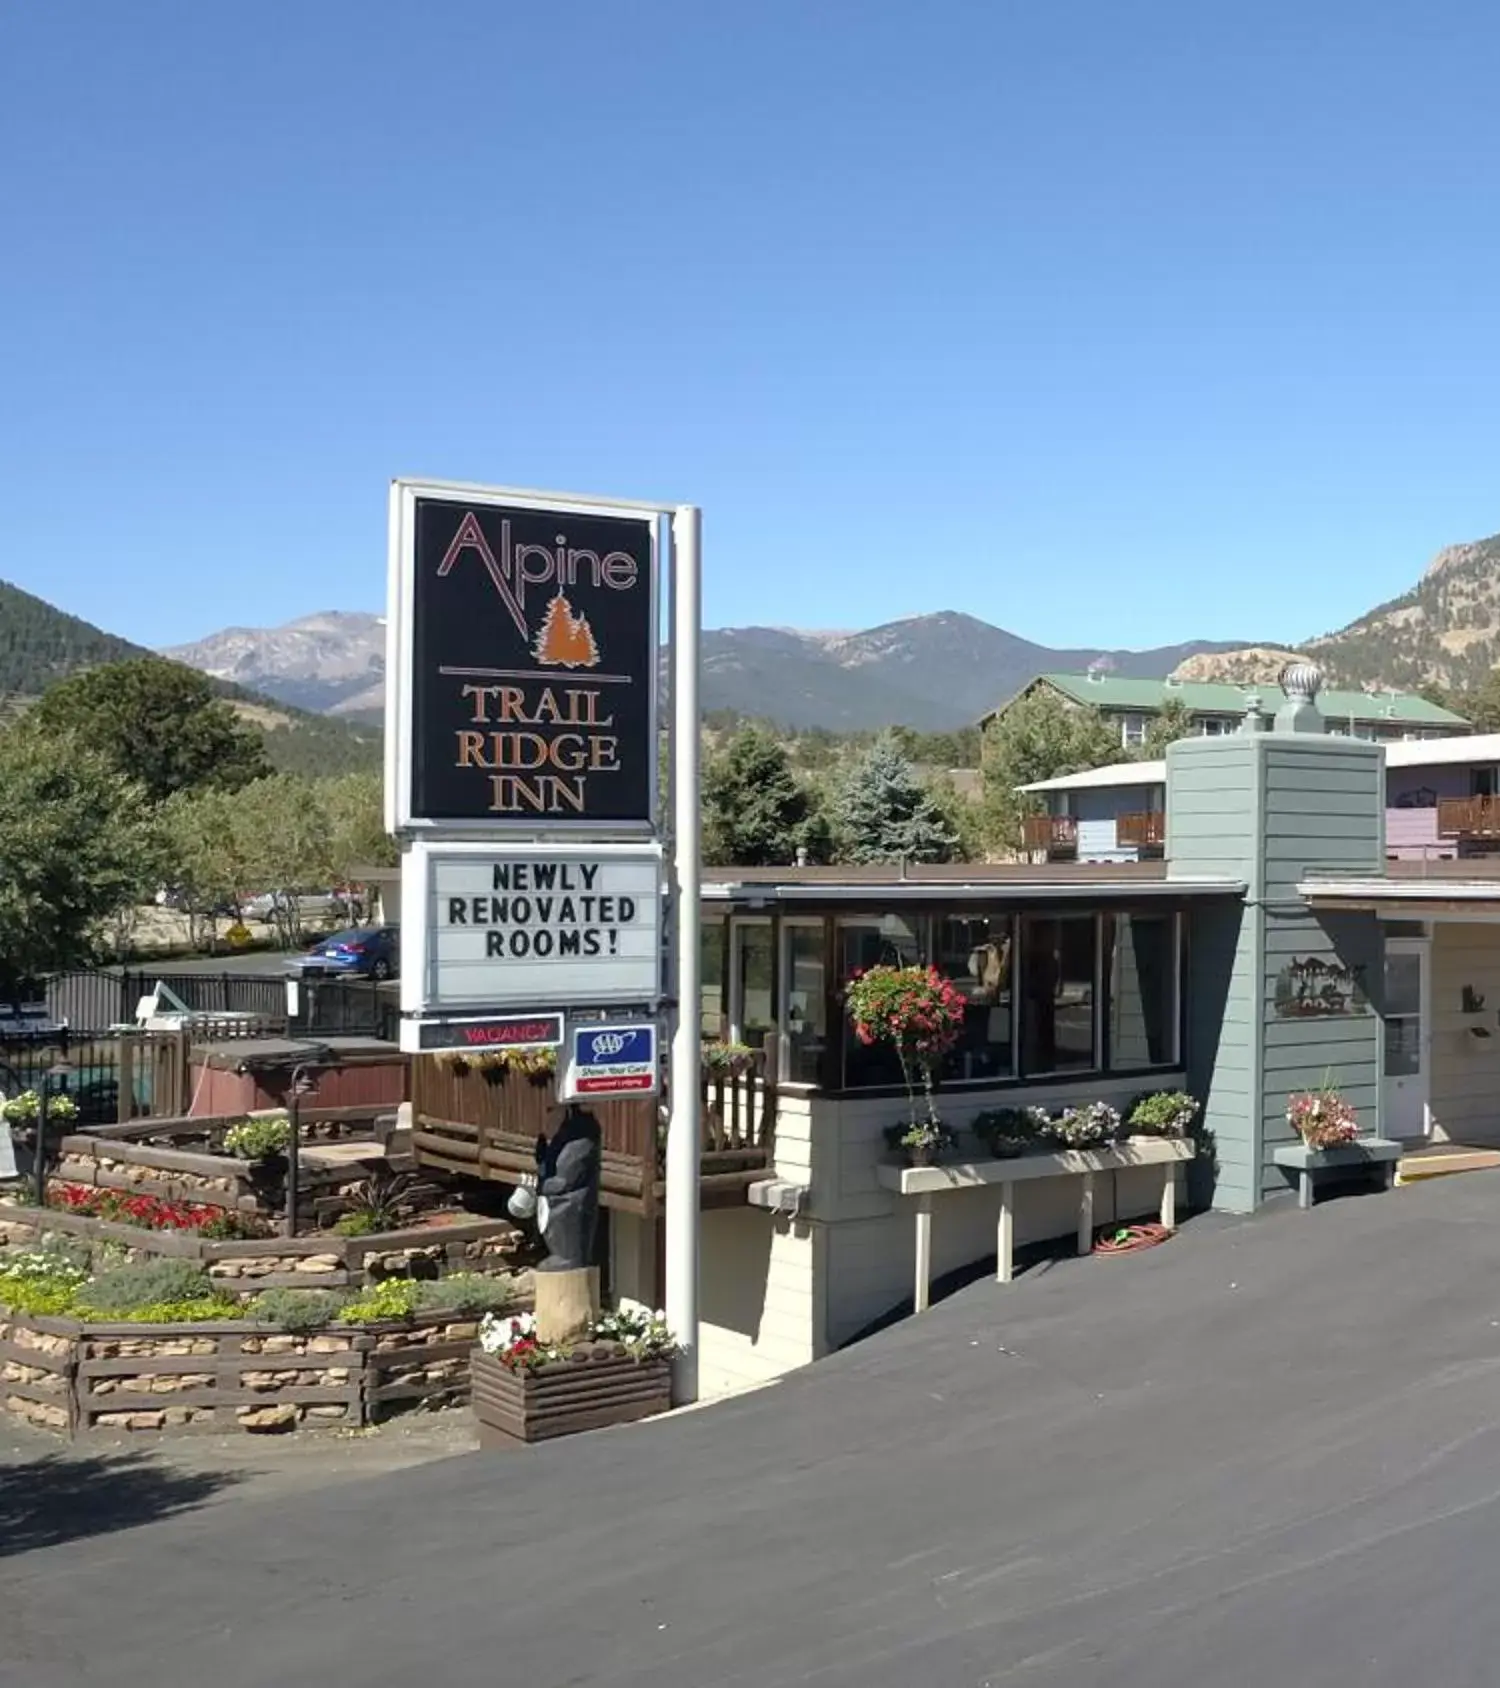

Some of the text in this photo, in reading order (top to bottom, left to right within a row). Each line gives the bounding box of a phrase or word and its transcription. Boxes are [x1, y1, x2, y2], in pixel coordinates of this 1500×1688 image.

[437, 511, 639, 642] Alpine
[462, 684, 614, 727] TRAIL
[455, 730, 621, 772] RIDGE
[488, 775, 587, 812] INN
[493, 863, 599, 891] NEWLY
[449, 896, 636, 925] RENOVATED
[486, 928, 619, 957] ROOMS!
[464, 1023, 550, 1042] VACANCY
[594, 1034, 621, 1053] AAA
